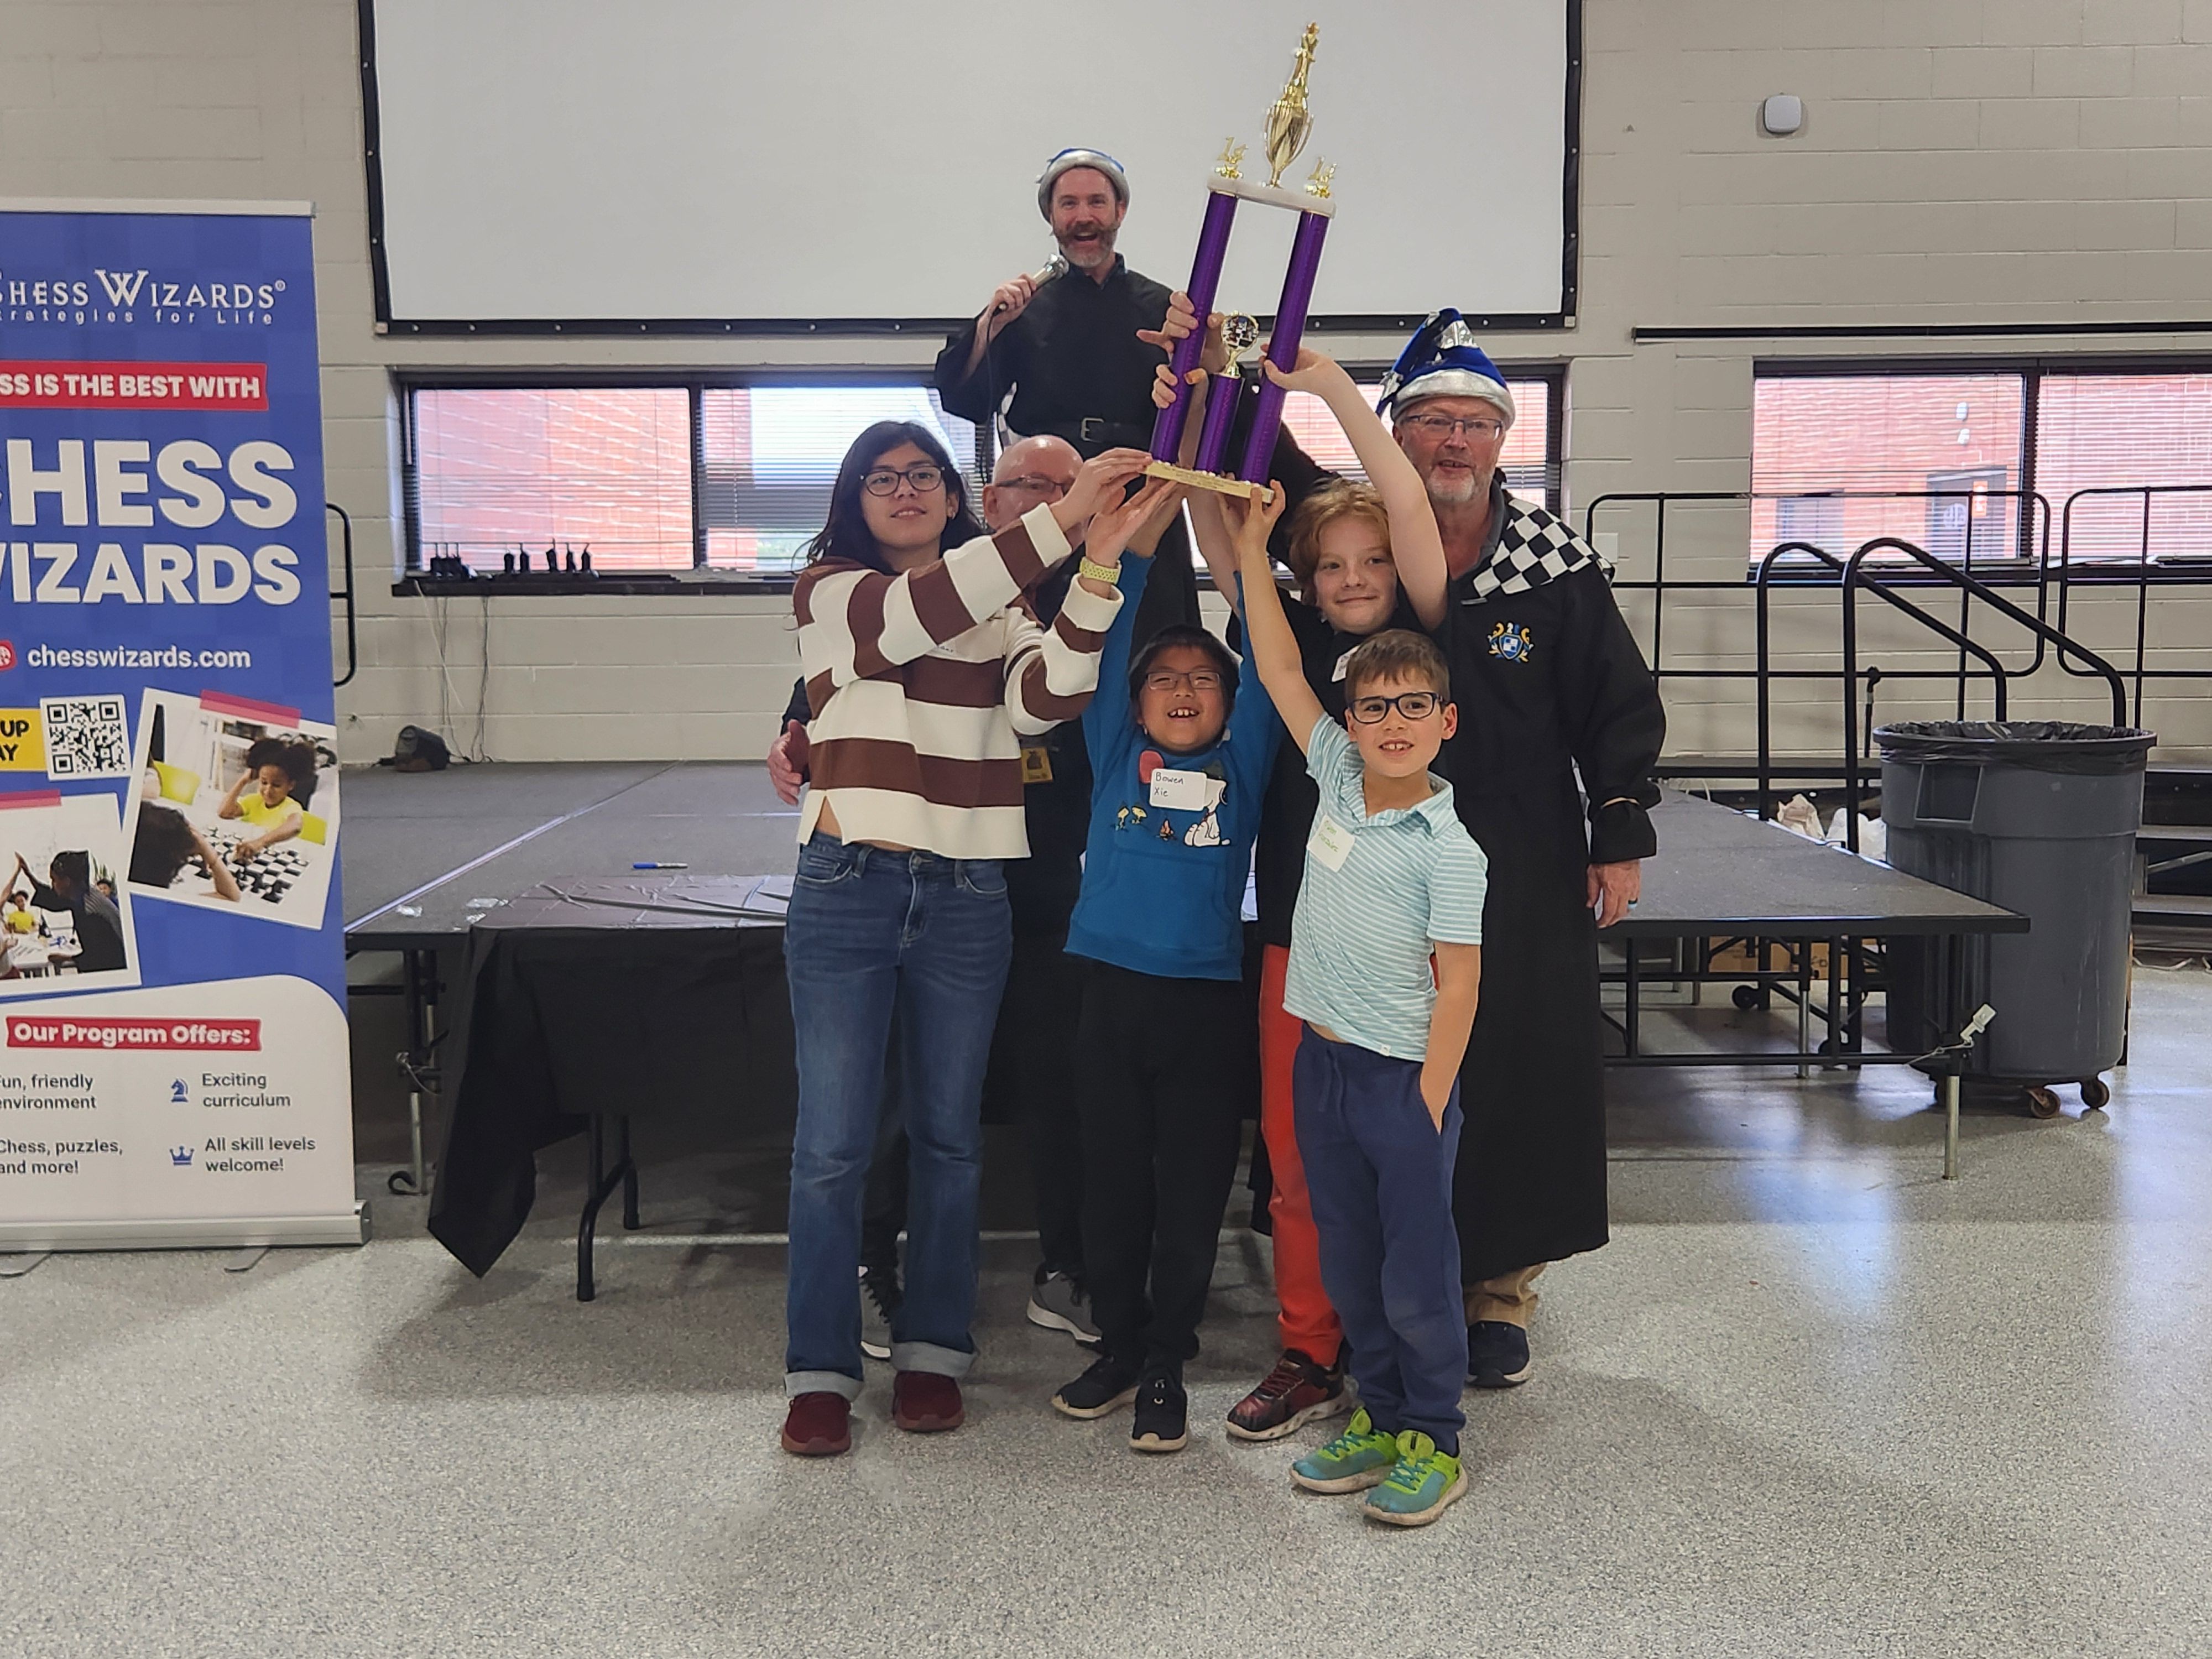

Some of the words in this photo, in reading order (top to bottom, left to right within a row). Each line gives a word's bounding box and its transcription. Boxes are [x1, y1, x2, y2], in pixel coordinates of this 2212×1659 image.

[0, 270, 88, 306] HESS
[156, 309, 194, 323] for
[217, 310, 272, 324] Life
[35, 374, 59, 395] IS
[64, 375, 114, 397] THE
[119, 375, 184, 397] BEST
[189, 377, 260, 398] WITH
[0, 439, 297, 529] HESS
[0, 542, 301, 605] IZARDS
[28, 644, 251, 668] chesswizards.com
[0, 720, 29, 738] UP
[1156, 772, 1183, 784] Bowen
[1154, 787, 1168, 797] Xie
[14, 1023, 58, 1041] Our
[62, 1024, 167, 1047] Program
[171, 1025, 251, 1044] Offers:
[0, 1075, 27, 1091] un,
[32, 1073, 93, 1092] friendly
[202, 1073, 267, 1089] Exciting
[203, 1093, 291, 1107] curriculum
[56, 1139, 123, 1156] puzzles,
[205, 1137, 226, 1151] All
[231, 1137, 264, 1151] skill
[269, 1136, 316, 1150] levels
[0, 1160, 26, 1174] and
[32, 1160, 79, 1174] more!
[206, 1158, 284, 1172] welcome!
